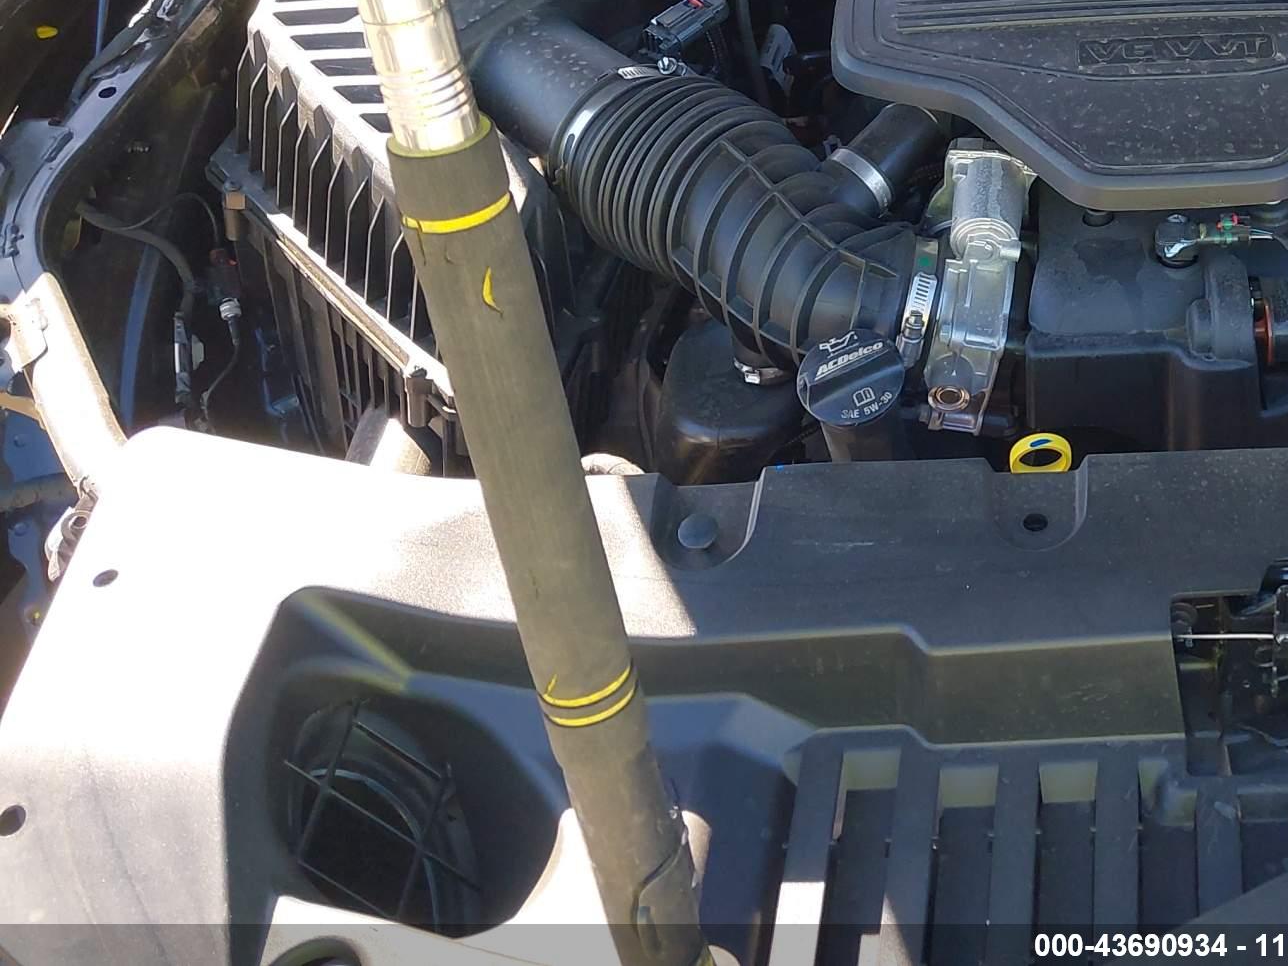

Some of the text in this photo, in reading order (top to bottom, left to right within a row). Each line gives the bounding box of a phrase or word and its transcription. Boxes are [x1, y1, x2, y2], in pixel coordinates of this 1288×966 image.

[815, 341, 884, 377] ACDelco
[841, 391, 893, 419] SAE 5W-30
